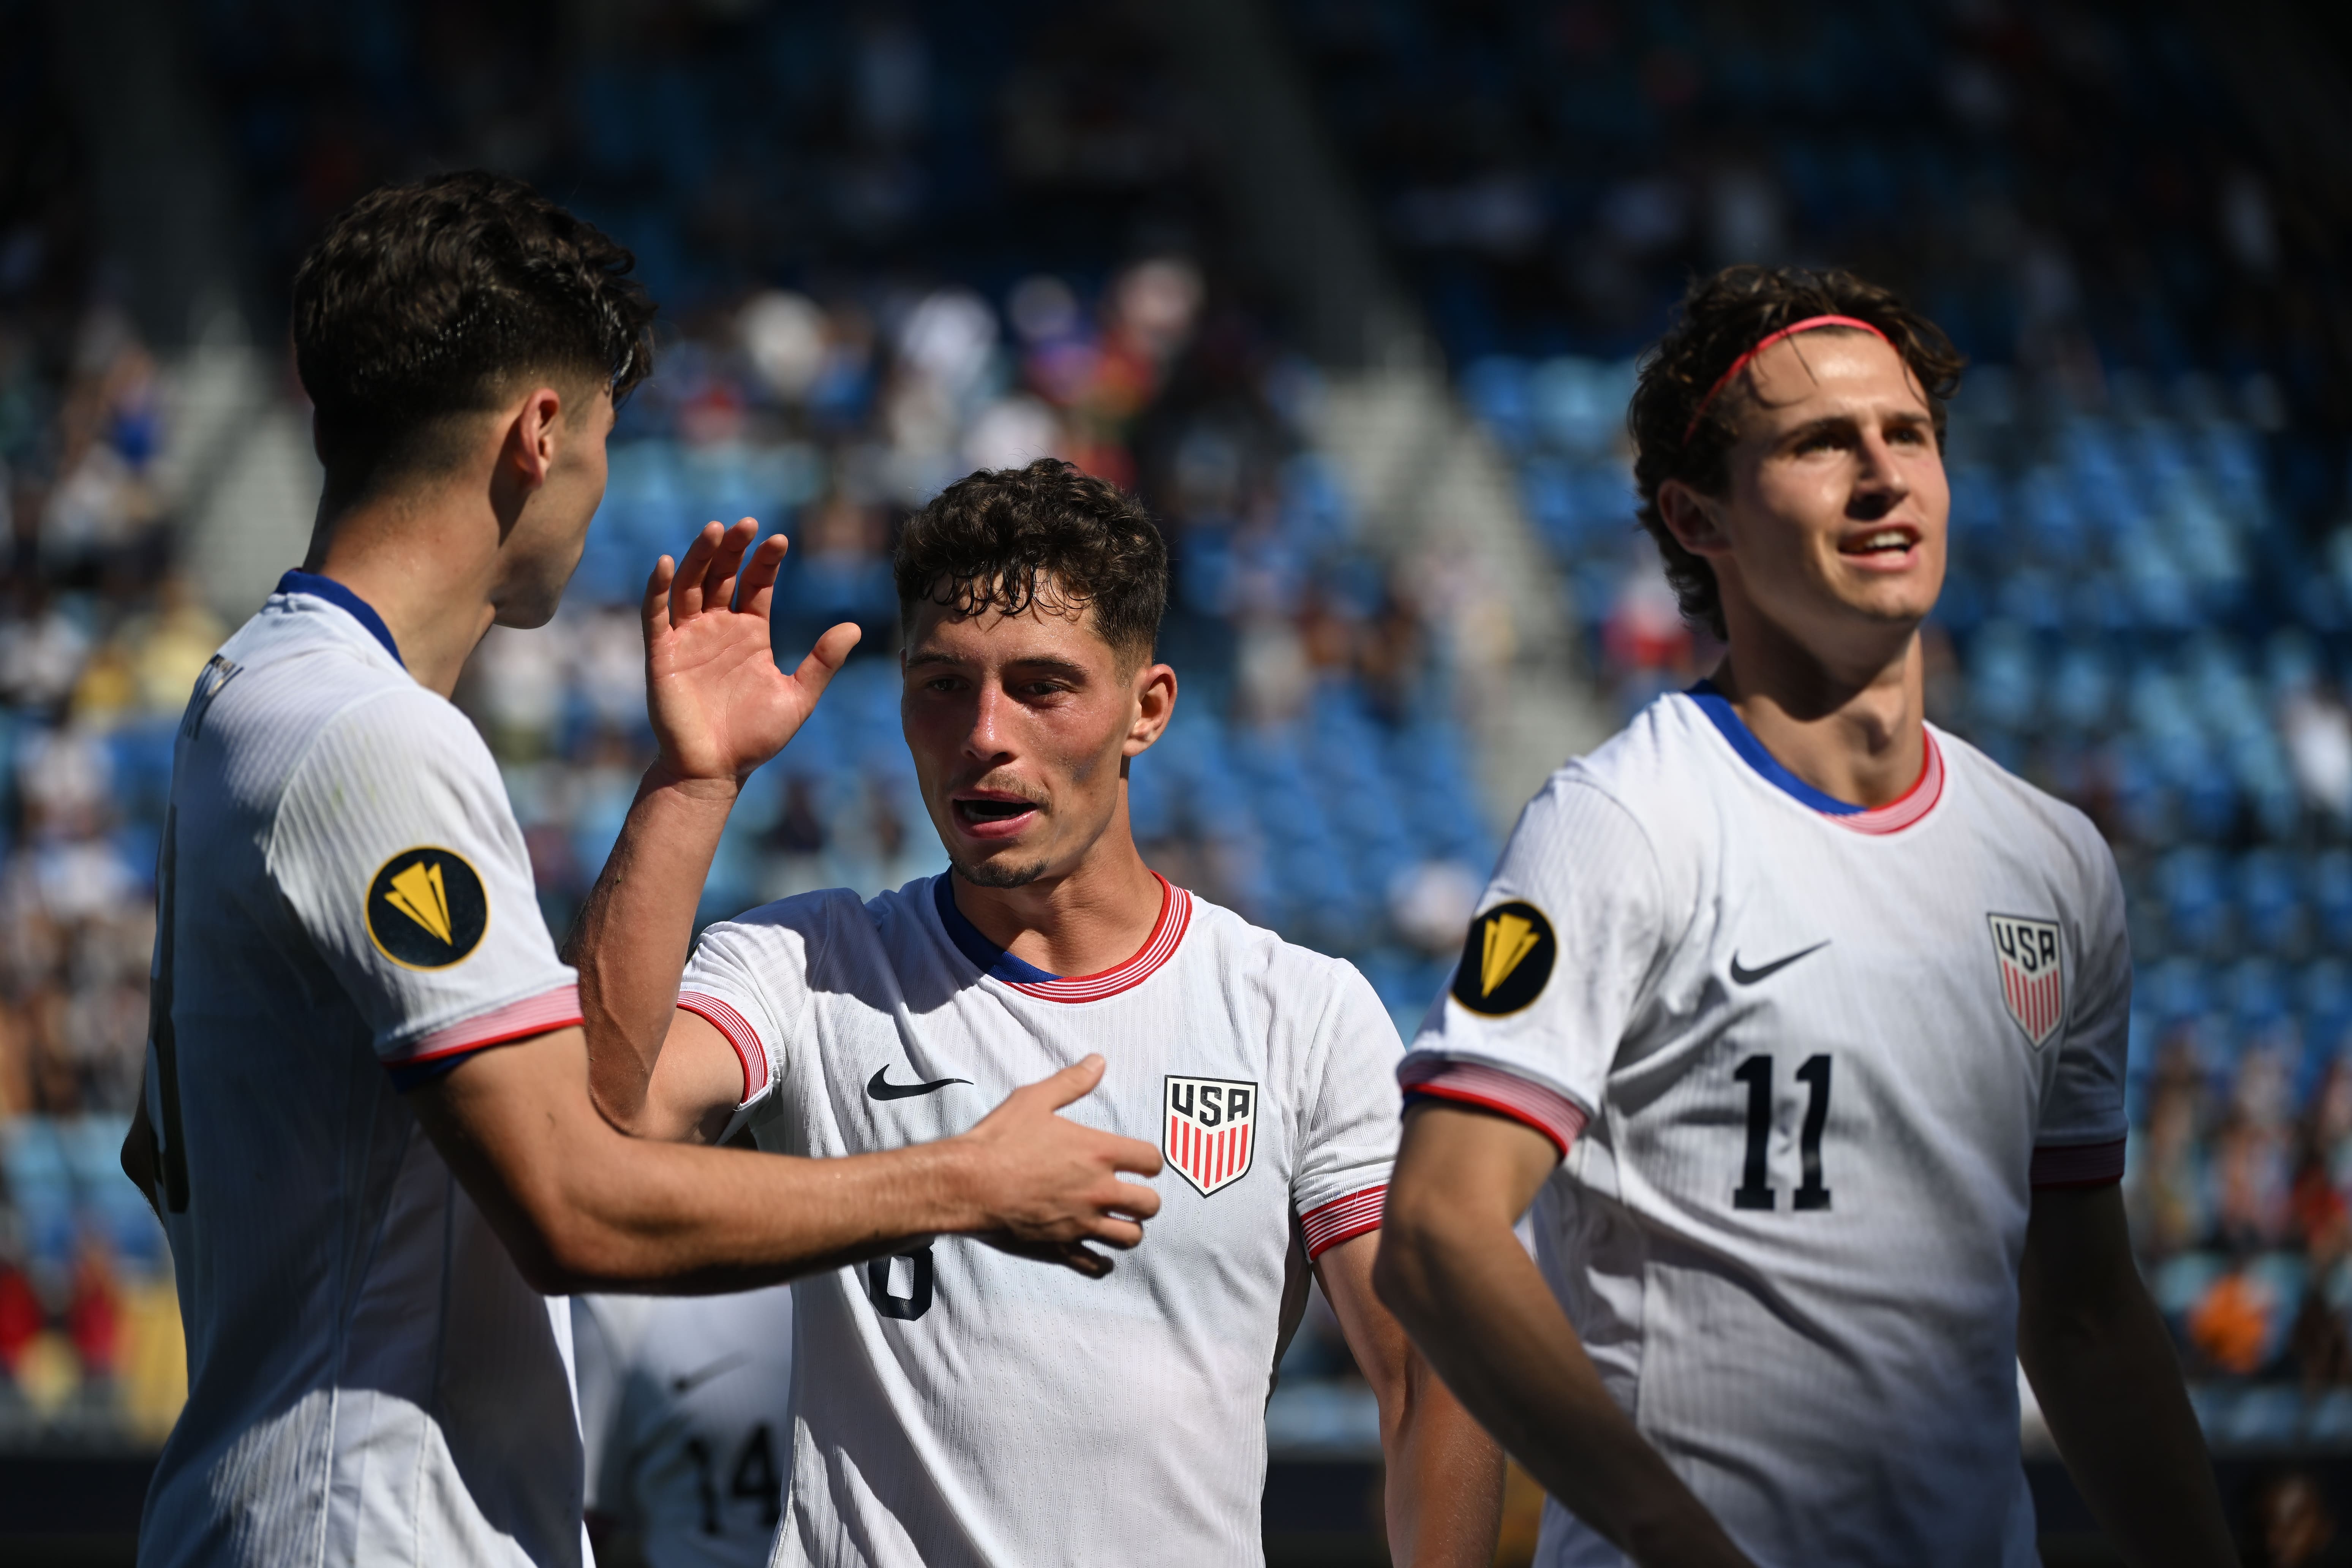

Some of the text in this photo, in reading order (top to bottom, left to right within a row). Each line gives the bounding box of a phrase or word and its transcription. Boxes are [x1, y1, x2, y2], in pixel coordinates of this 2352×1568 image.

[1996, 923, 2055, 972] USA
[1172, 1083, 1250, 1127] USA
[1733, 1054, 1832, 1212] 11
[686, 1420, 780, 1535] 14
